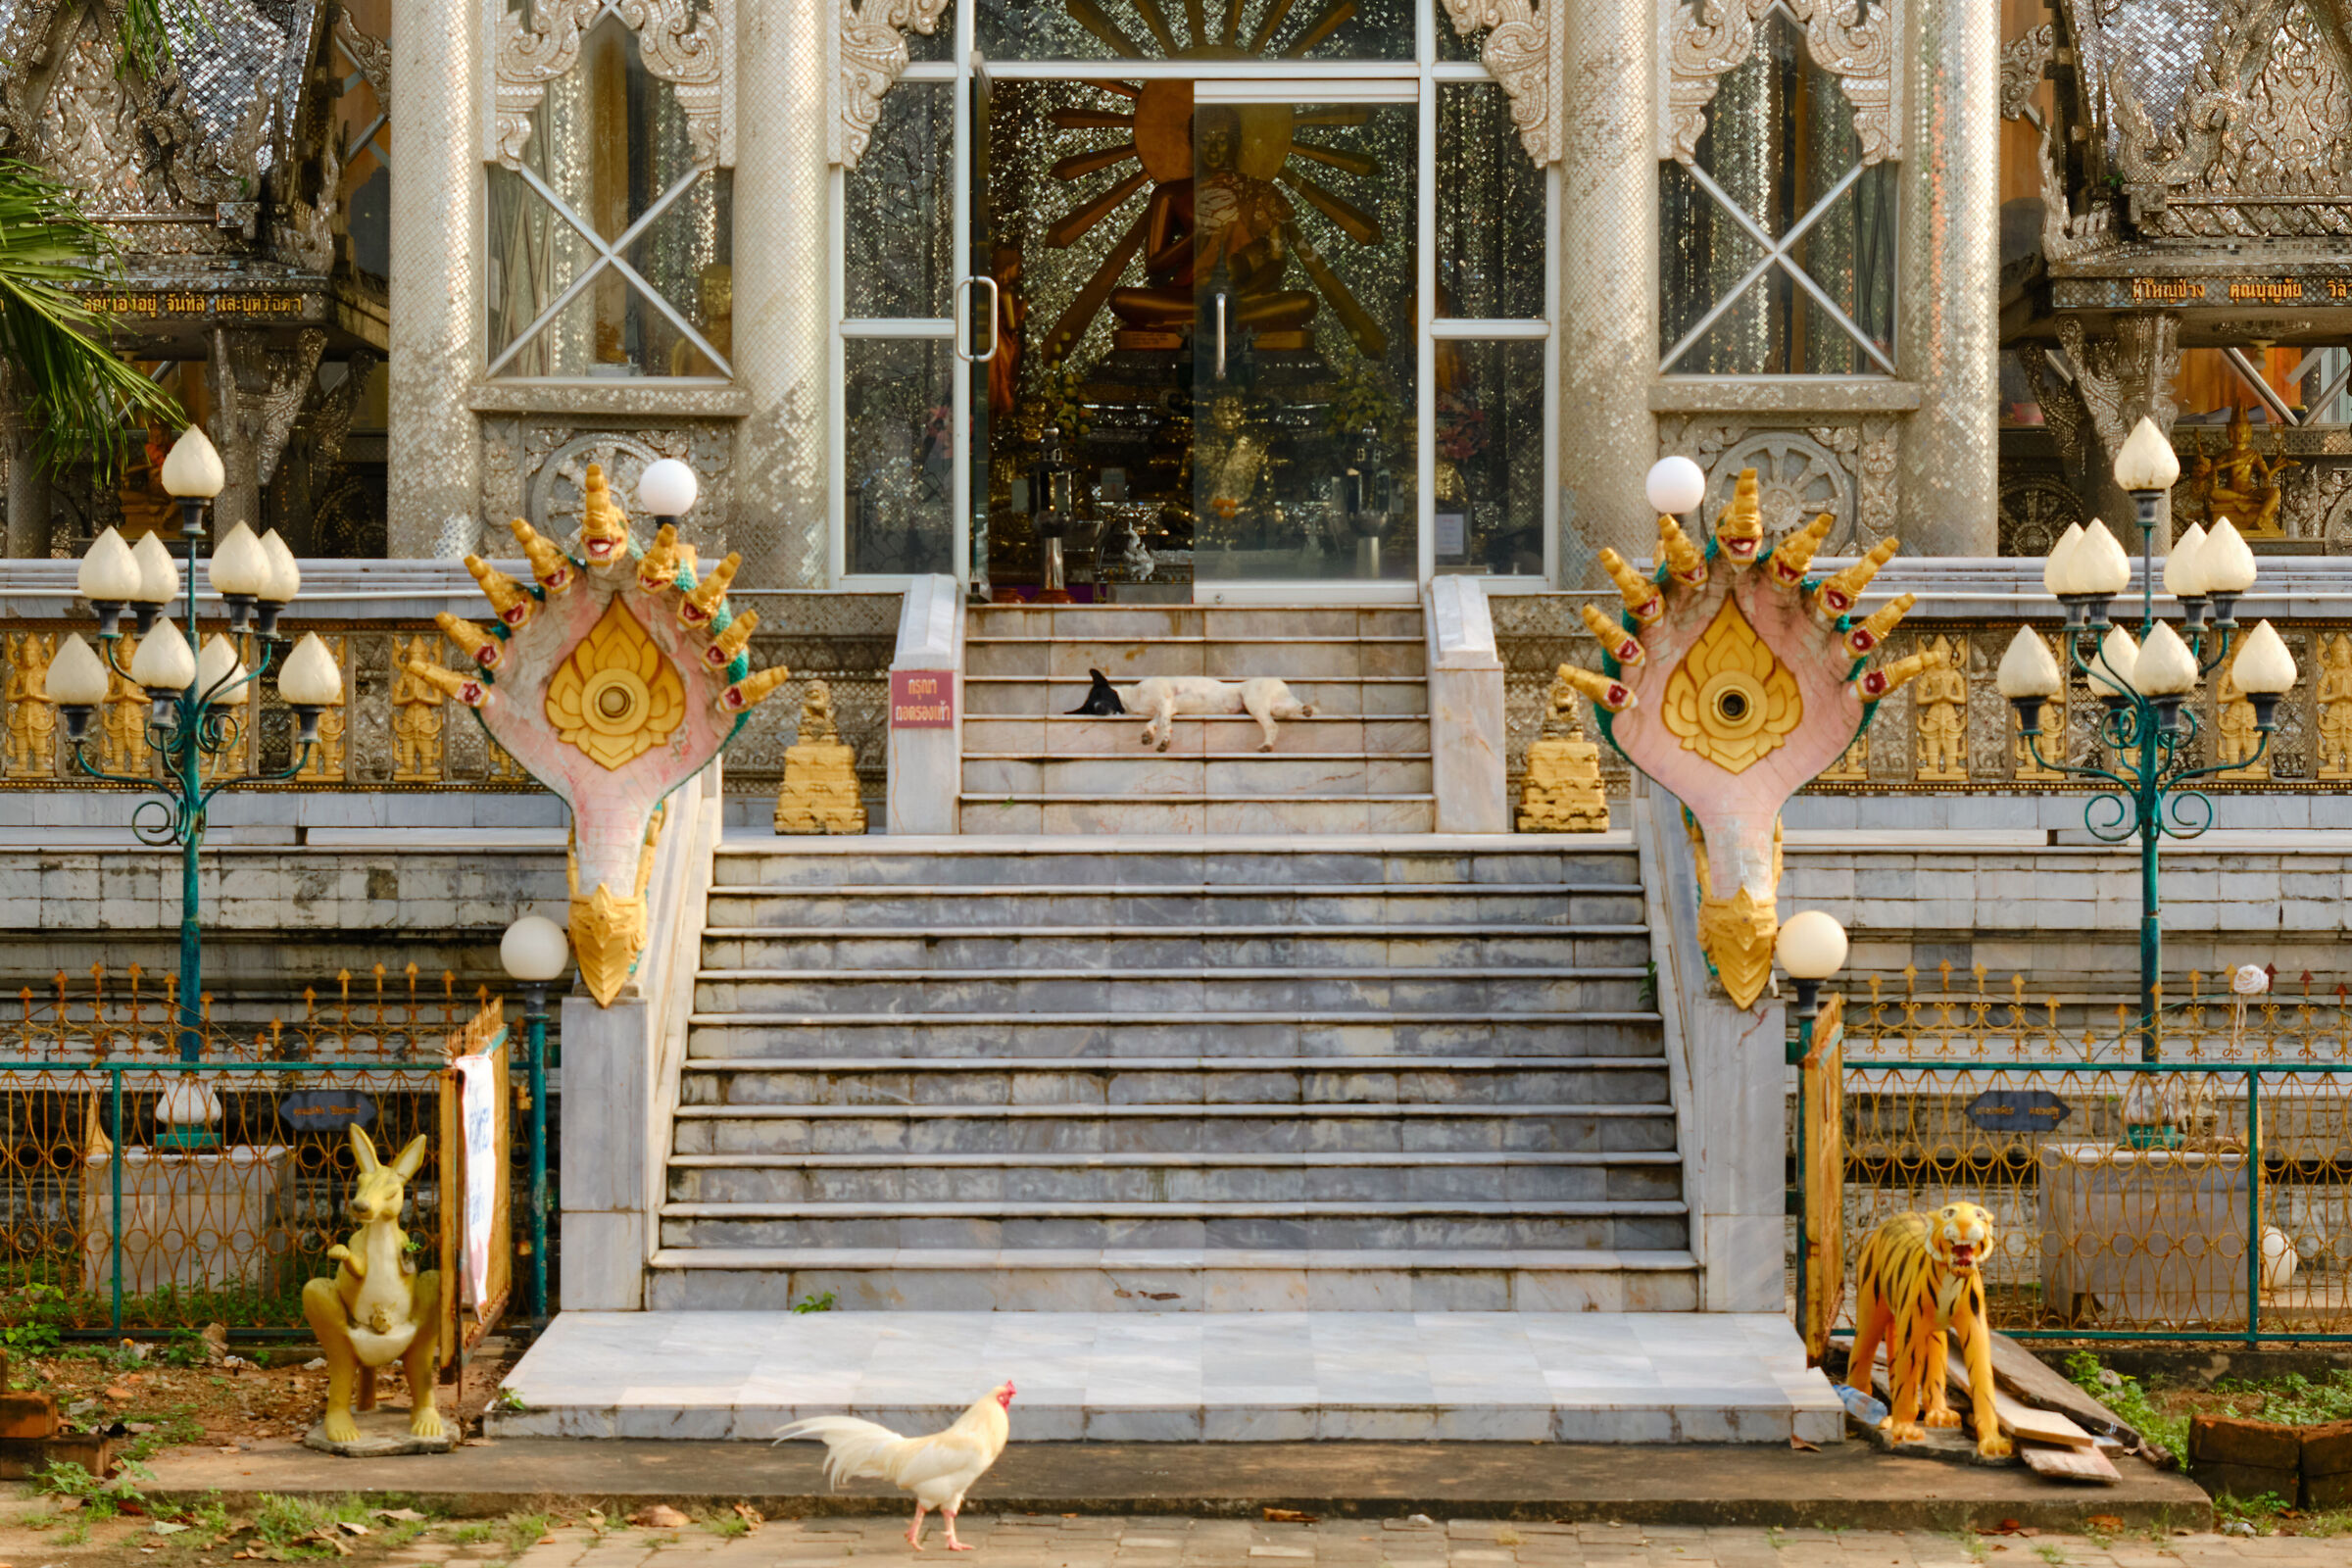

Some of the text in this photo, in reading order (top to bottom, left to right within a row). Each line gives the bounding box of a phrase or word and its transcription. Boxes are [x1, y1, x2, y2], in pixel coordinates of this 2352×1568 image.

[2326, 280, 2352, 299] วิล
[907, 678, 938, 701] กรุณา
[895, 699, 951, 721] ถอดรองเท้า
